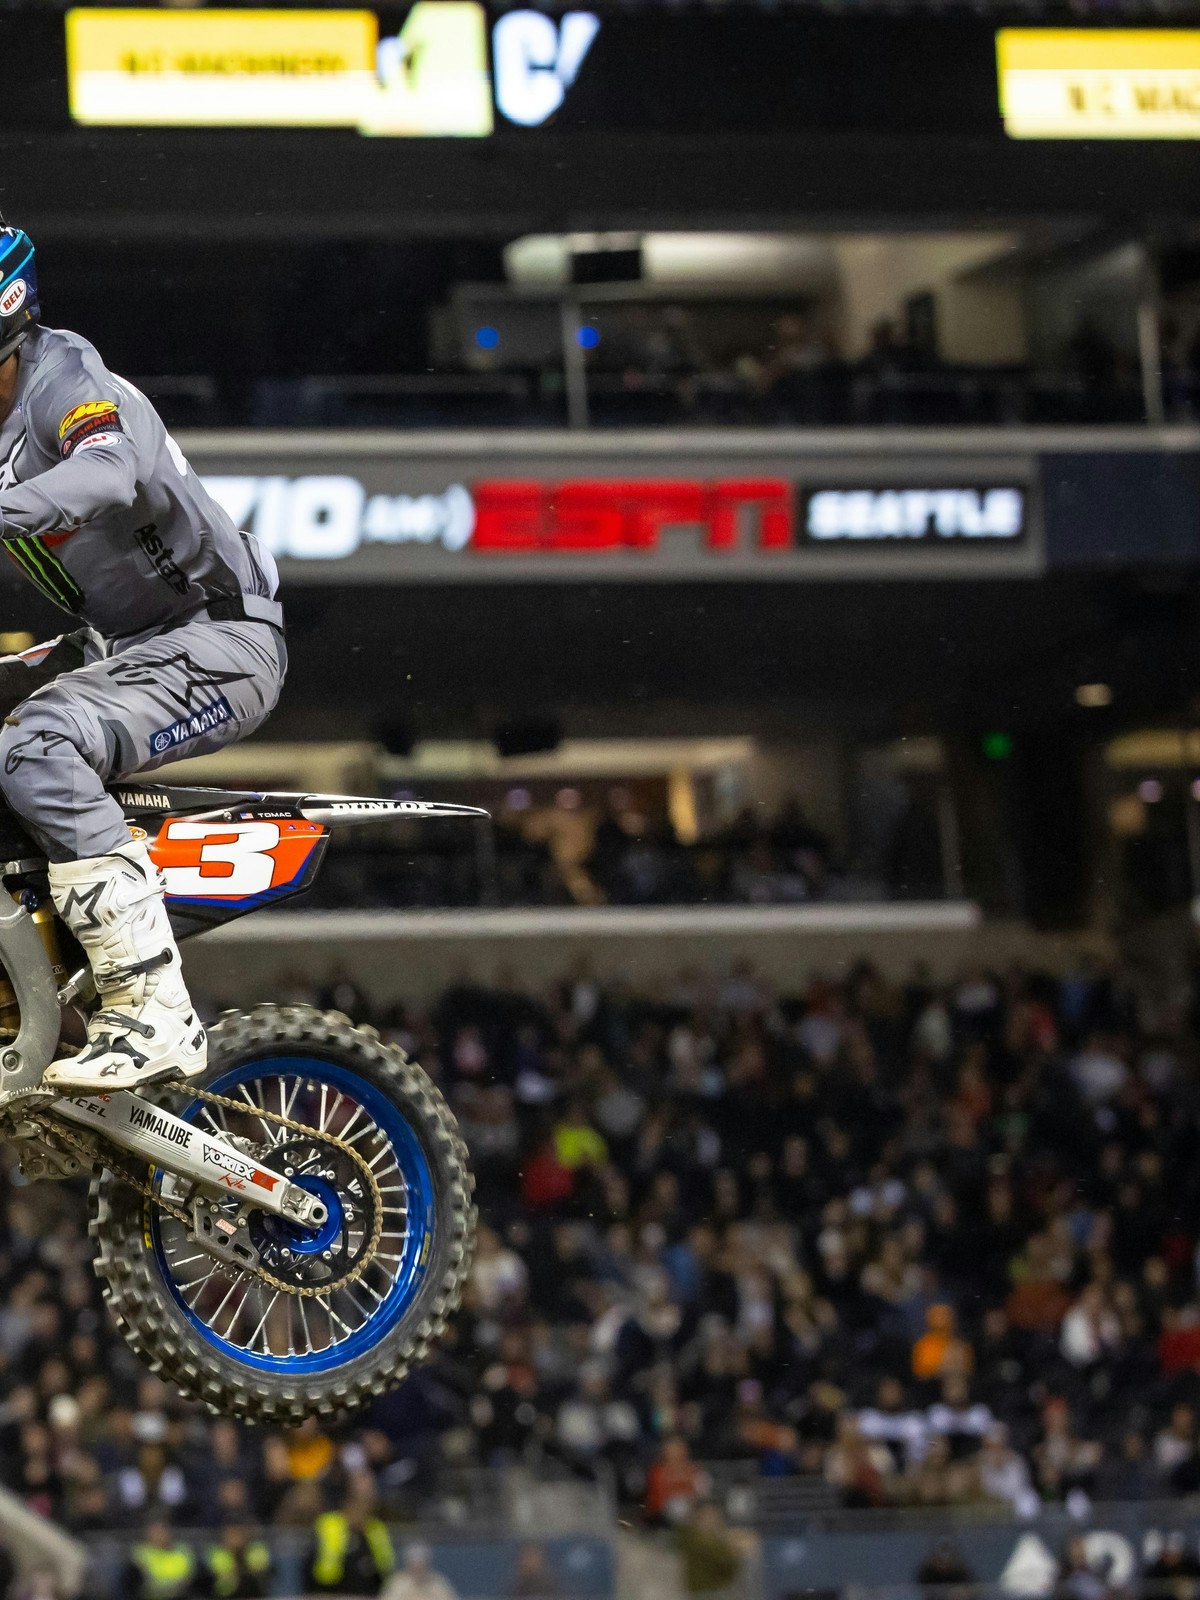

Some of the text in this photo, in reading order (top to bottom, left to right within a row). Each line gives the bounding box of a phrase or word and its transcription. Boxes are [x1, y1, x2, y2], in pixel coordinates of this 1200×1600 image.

[2, 285, 25, 312] BELL
[472, 477, 792, 553] ESPN
[808, 488, 1022, 540] SEATTLE
[171, 703, 228, 743] YAMAHA
[118, 791, 171, 809] YAMAHA
[257, 811, 292, 819] TOMAC
[158, 821, 281, 896] 3
[128, 1105, 193, 1149] YAMALUBE
[203, 1143, 256, 1183] VORTEX
